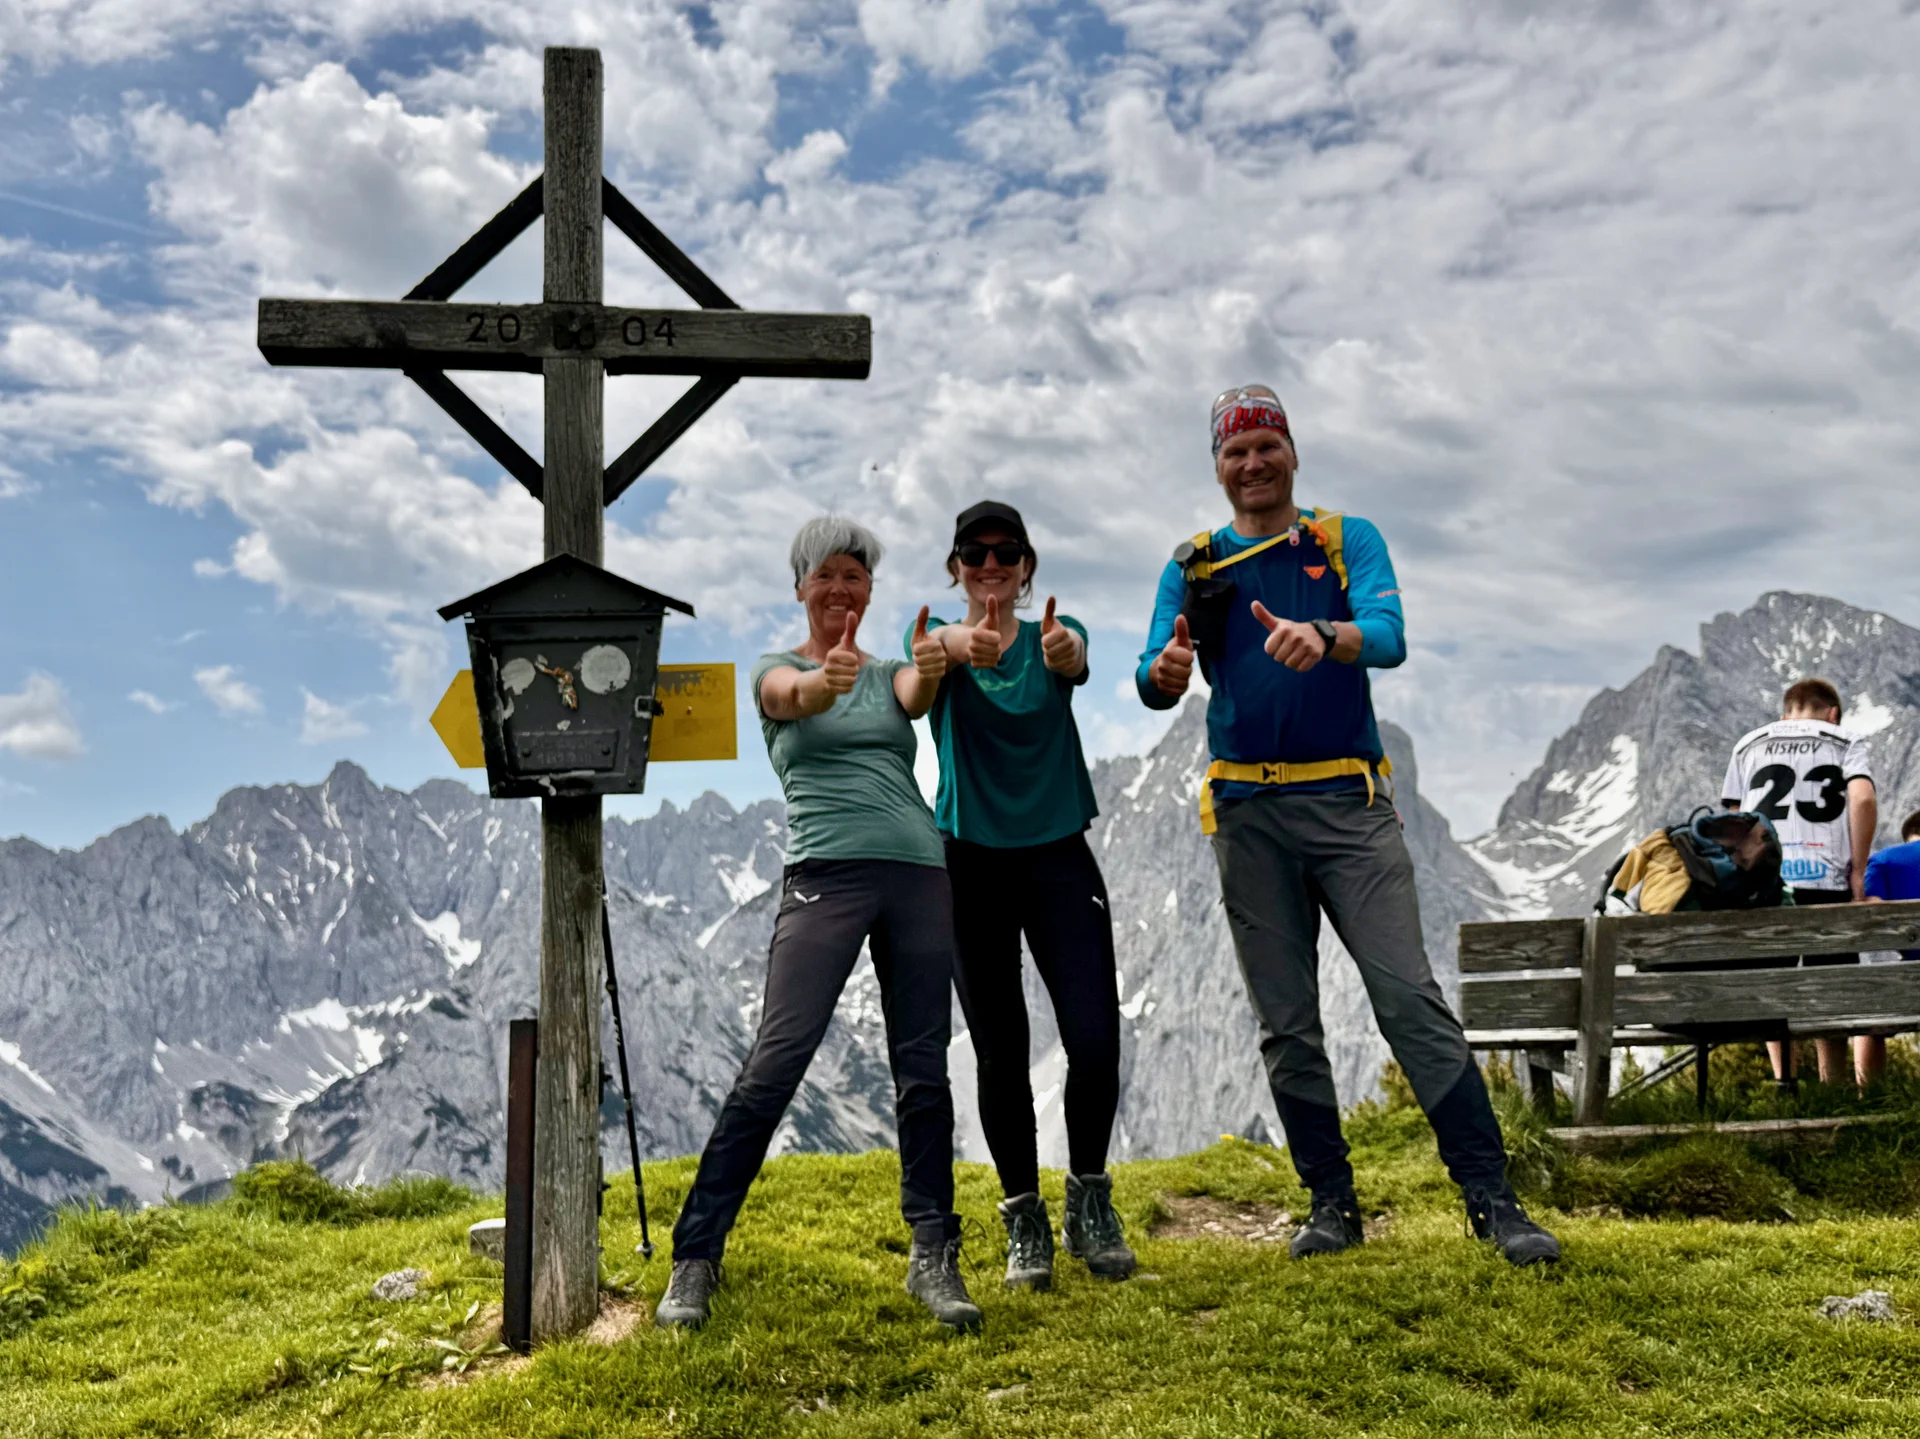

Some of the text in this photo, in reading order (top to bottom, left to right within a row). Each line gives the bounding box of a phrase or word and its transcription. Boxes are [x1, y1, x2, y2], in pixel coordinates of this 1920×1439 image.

[465, 312, 677, 347] 20 04
[1749, 764, 1847, 823] 23
